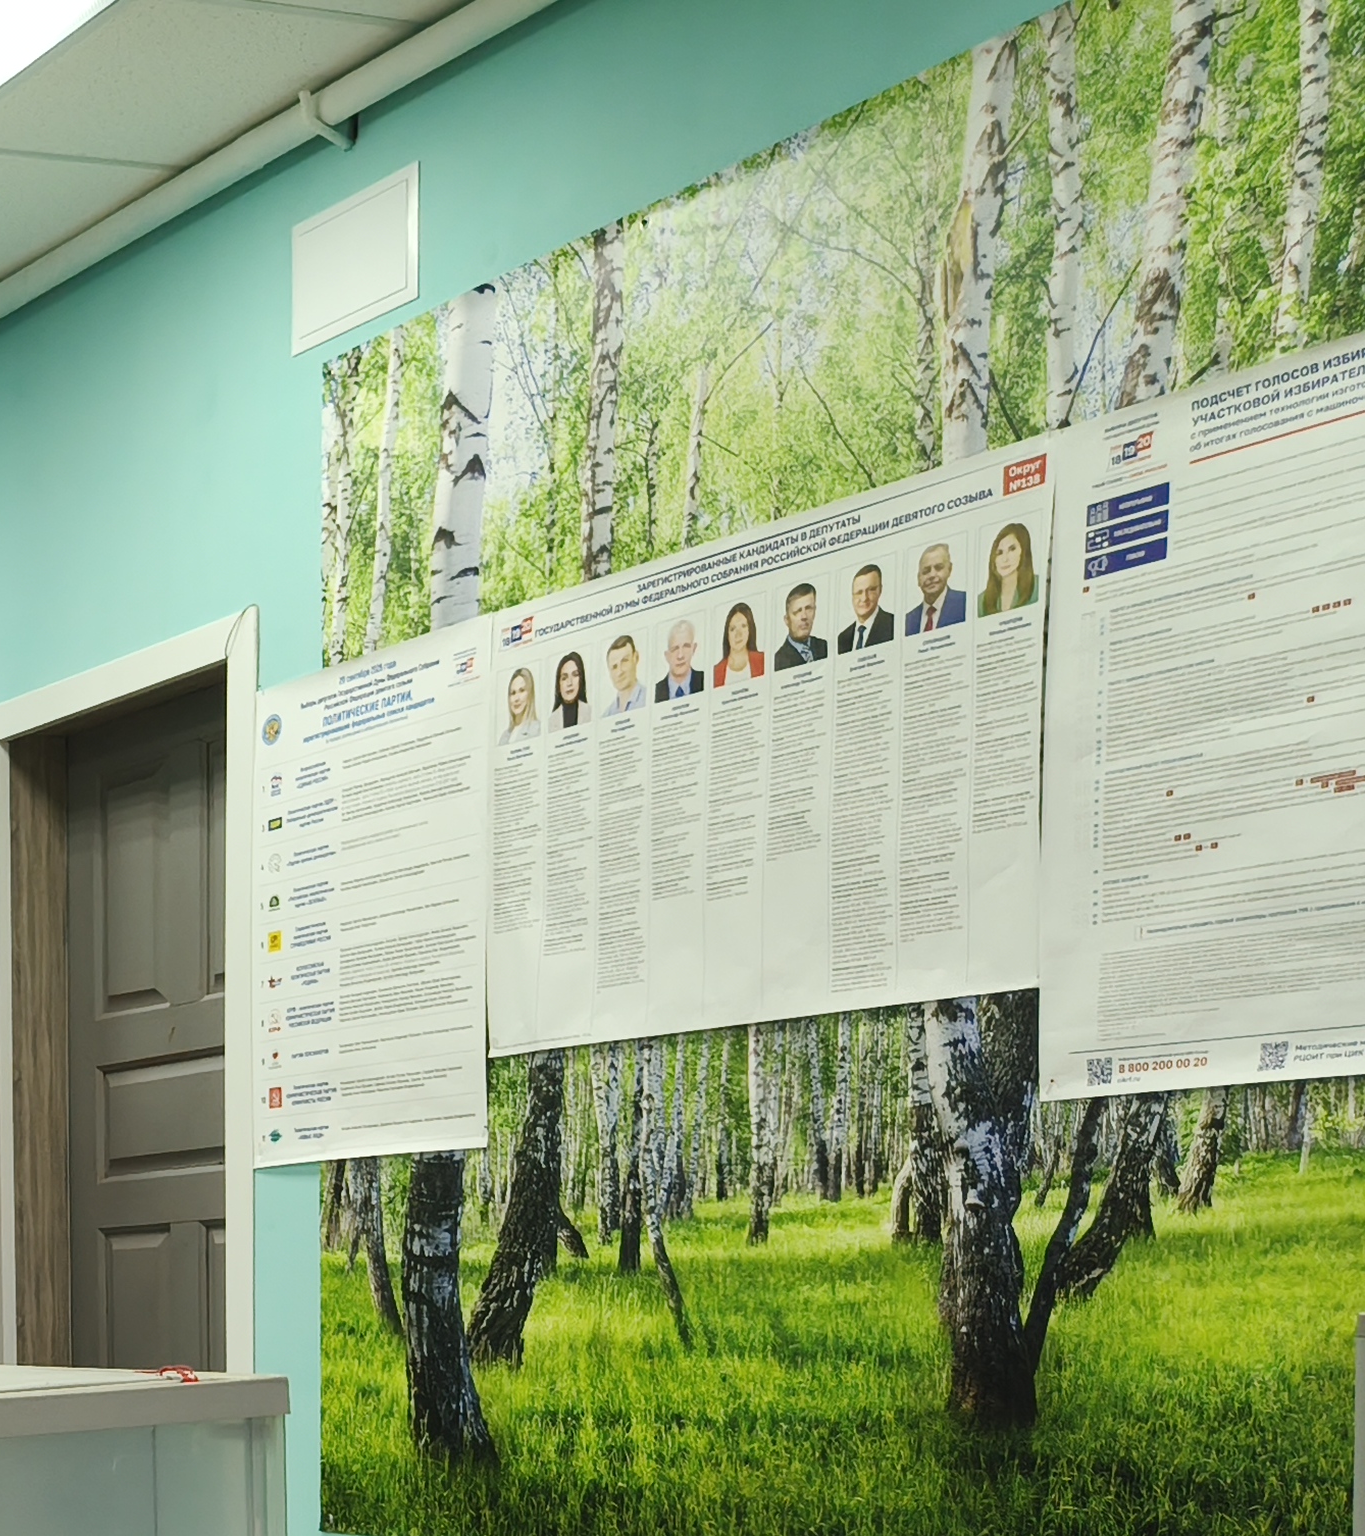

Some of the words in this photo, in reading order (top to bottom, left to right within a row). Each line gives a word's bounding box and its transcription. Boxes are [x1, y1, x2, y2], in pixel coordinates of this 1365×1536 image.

[1191, 383, 1252, 411] ПОДСЧЕТ
[1255, 362, 1319, 391] ГОЛОСОВ
[1191, 389, 1280, 427] УЧАСТКОВОЙ
[1198, 412, 1267, 438] применением
[1269, 392, 1329, 416] технологии
[1137, 435, 1151, 449] 20
[1190, 441, 1201, 453] об
[1203, 431, 1236, 449] итогах
[1239, 412, 1305, 438] голосования
[1009, 461, 1042, 477] Округ
[1111, 454, 1122, 466] 18
[1009, 473, 1041, 492] №138
[534, 605, 613, 638] ГОСУДАРСТВЕННОЙ
[614, 597, 640, 614] ДУМЫ
[642, 577, 709, 604] ФЕДЕРАЛЬНОГО
[710, 560, 759, 584] СОБРАНИЯ
[760, 539, 827, 565] РОССИЙСКОЙ
[829, 520, 890, 546] ФЕДЕРАЦИИ
[891, 502, 945, 529] ДЕВЯТОГО
[946, 488, 993, 510] СОЗЫВА
[636, 554, 737, 593] ЗАРЕГИСТРИРОВАННЫЕ
[739, 534, 799, 559] КАНДИДАТЫ
[800, 531, 807, 541] В
[809, 514, 861, 540] ДЕПУТАТЫ
[322, 699, 379, 727] ПОЛИТИЧЕСКИЕ
[1118, 1064, 1125, 1073] 8
[1128, 1062, 1149, 1073] 800
[1152, 1060, 1173, 1071] 200
[1176, 1058, 1191, 1069] 00
[1193, 1057, 1208, 1068] 20
